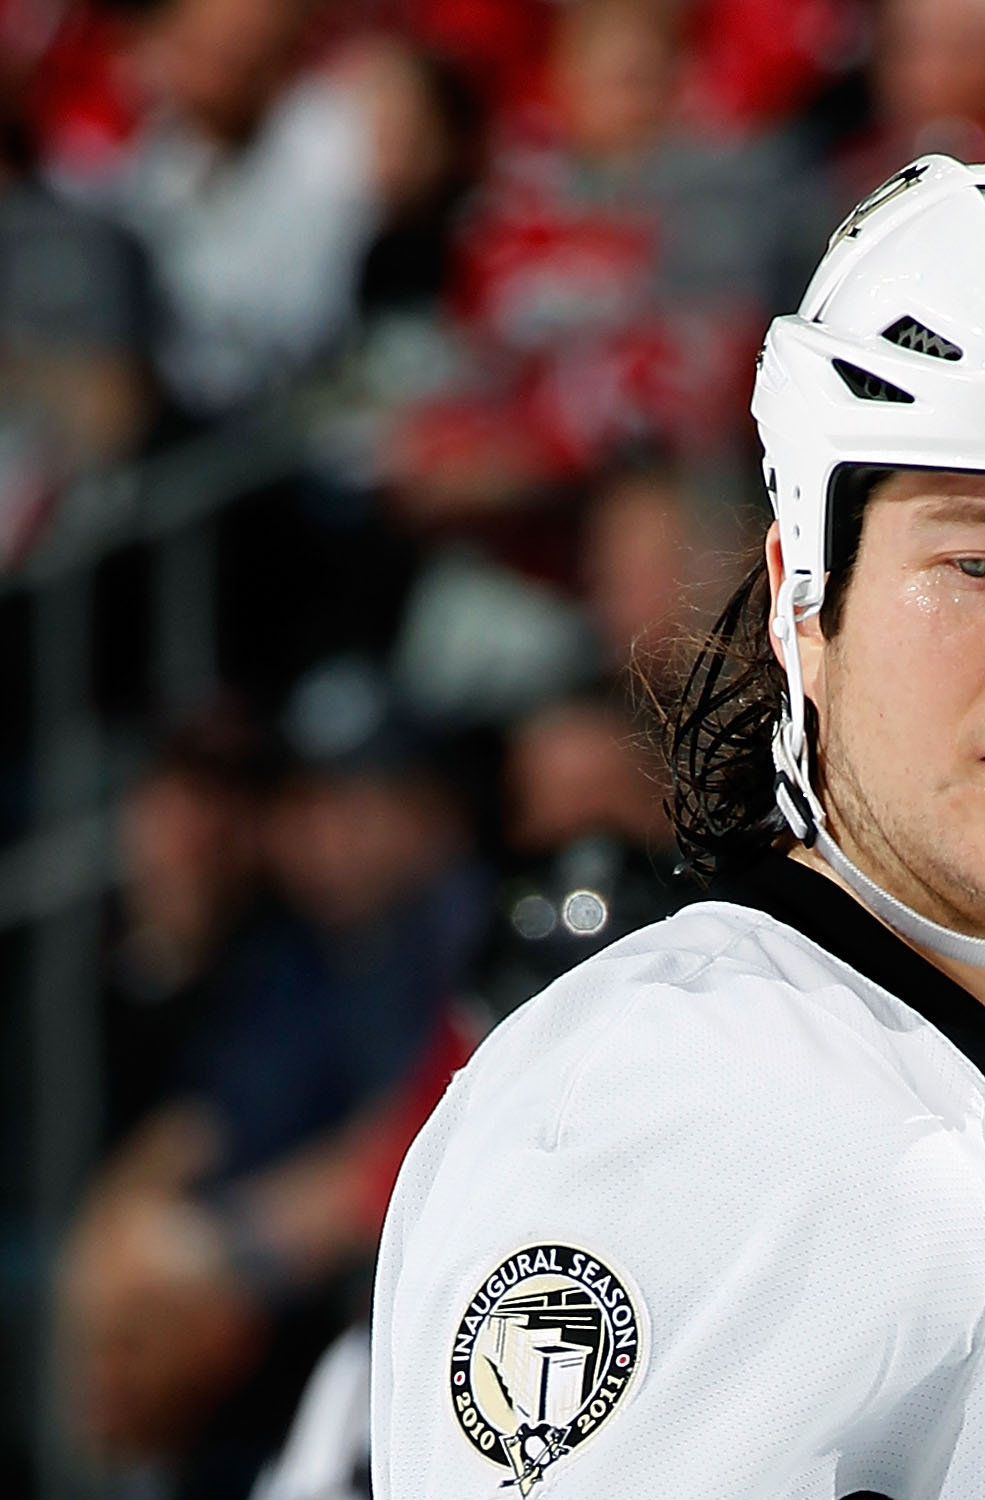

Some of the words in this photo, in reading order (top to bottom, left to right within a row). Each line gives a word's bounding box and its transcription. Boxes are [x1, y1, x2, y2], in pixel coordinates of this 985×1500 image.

[452, 1248, 563, 1362] INAUGURAL
[567, 1253, 637, 1351] SEASON
[455, 1391, 496, 1451] 2010
[576, 1373, 625, 1434] 2011
